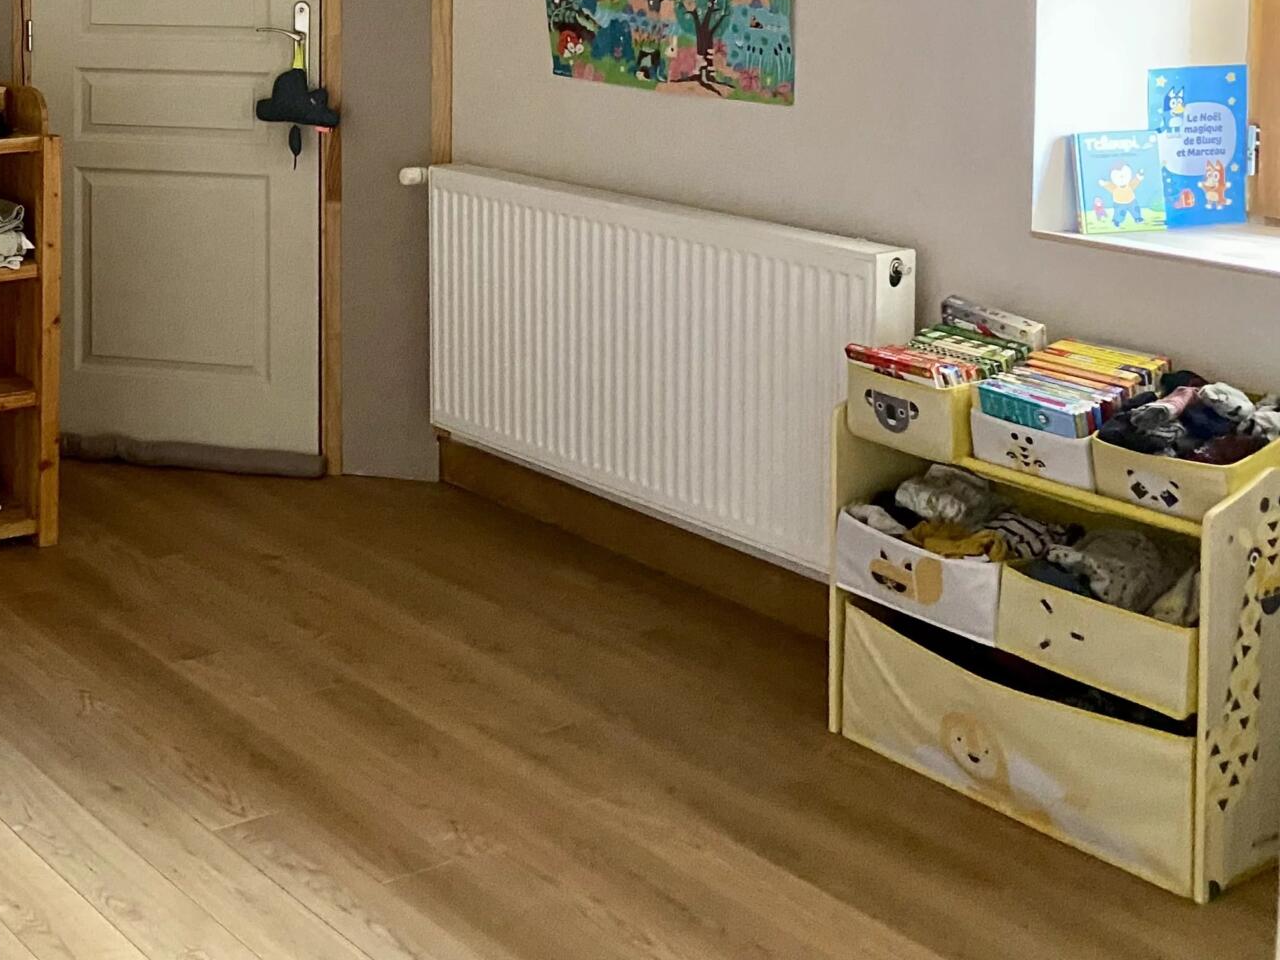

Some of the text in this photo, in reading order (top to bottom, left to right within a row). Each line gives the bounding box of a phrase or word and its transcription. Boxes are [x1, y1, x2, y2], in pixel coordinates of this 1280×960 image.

[1186, 111, 1221, 122] Le Noël
[1184, 124, 1223, 134] magique
[1183, 136, 1221, 145] de Bluey
[1176, 148, 1226, 157] et Marceau
